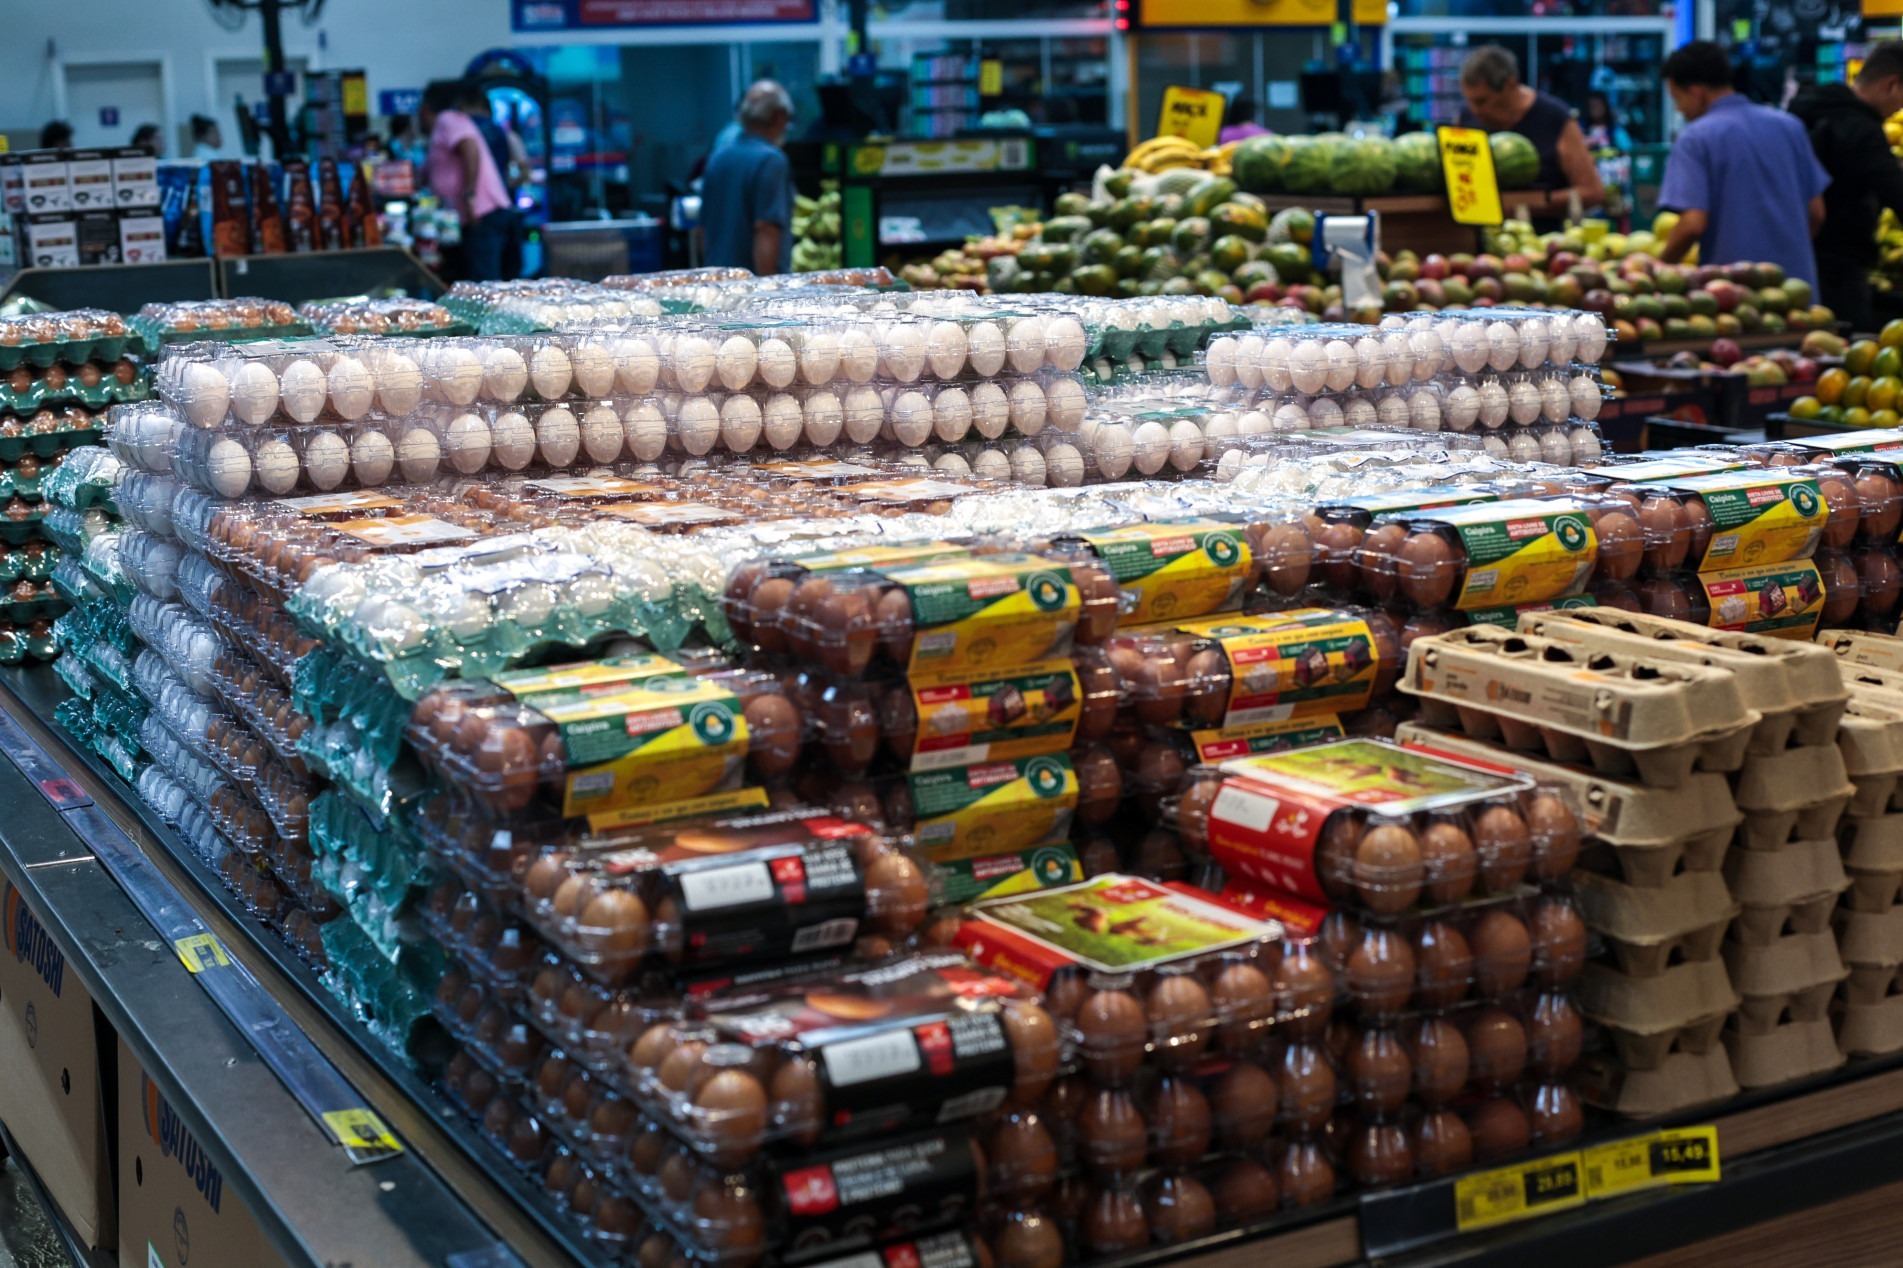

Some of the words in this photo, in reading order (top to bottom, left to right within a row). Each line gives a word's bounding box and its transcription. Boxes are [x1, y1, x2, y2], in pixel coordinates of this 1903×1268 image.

[1708, 494, 1737, 504] Caipira
[1464, 525, 1496, 536] Caipira
[17, 907, 64, 998] SATOSHI
